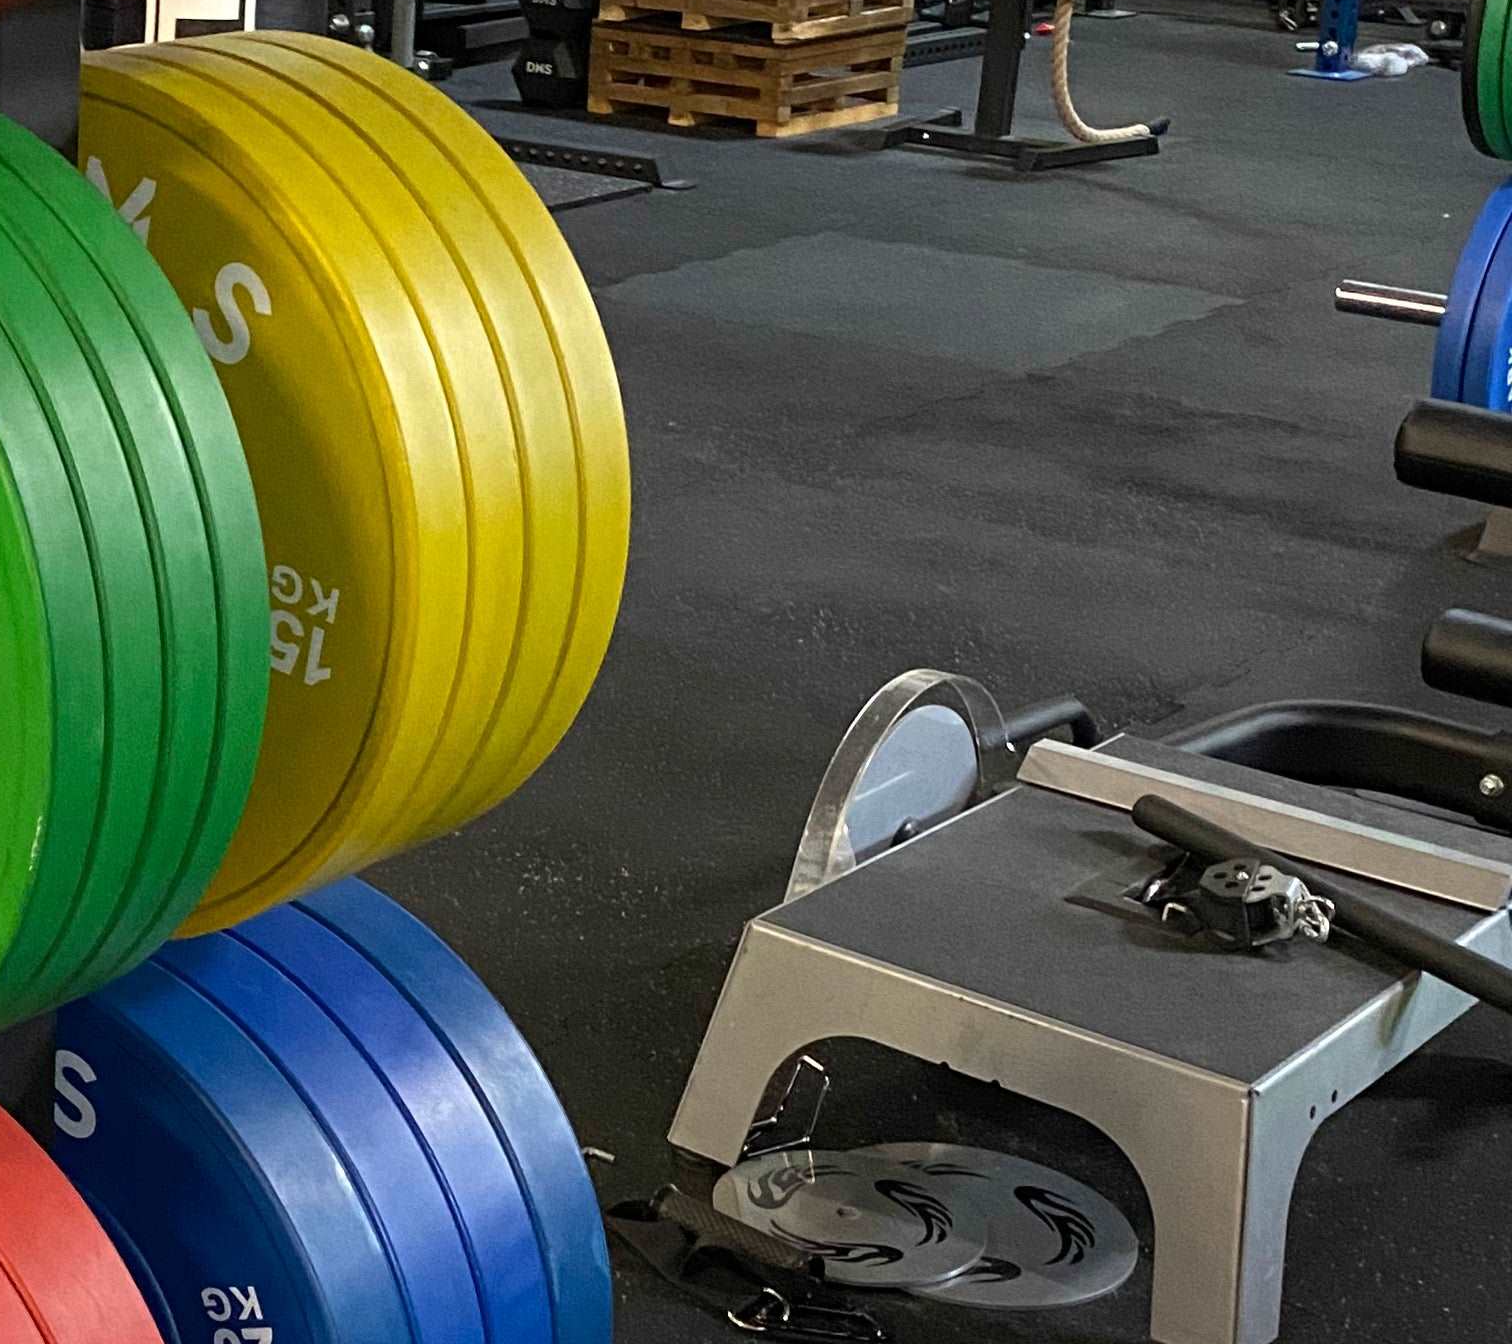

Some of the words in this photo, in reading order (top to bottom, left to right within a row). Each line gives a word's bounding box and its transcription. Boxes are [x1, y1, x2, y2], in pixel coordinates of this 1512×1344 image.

[526, 61, 553, 76] DMS
[271, 565, 340, 624] KG
[269, 609, 332, 686] 15
[201, 1285, 264, 1321] KG
